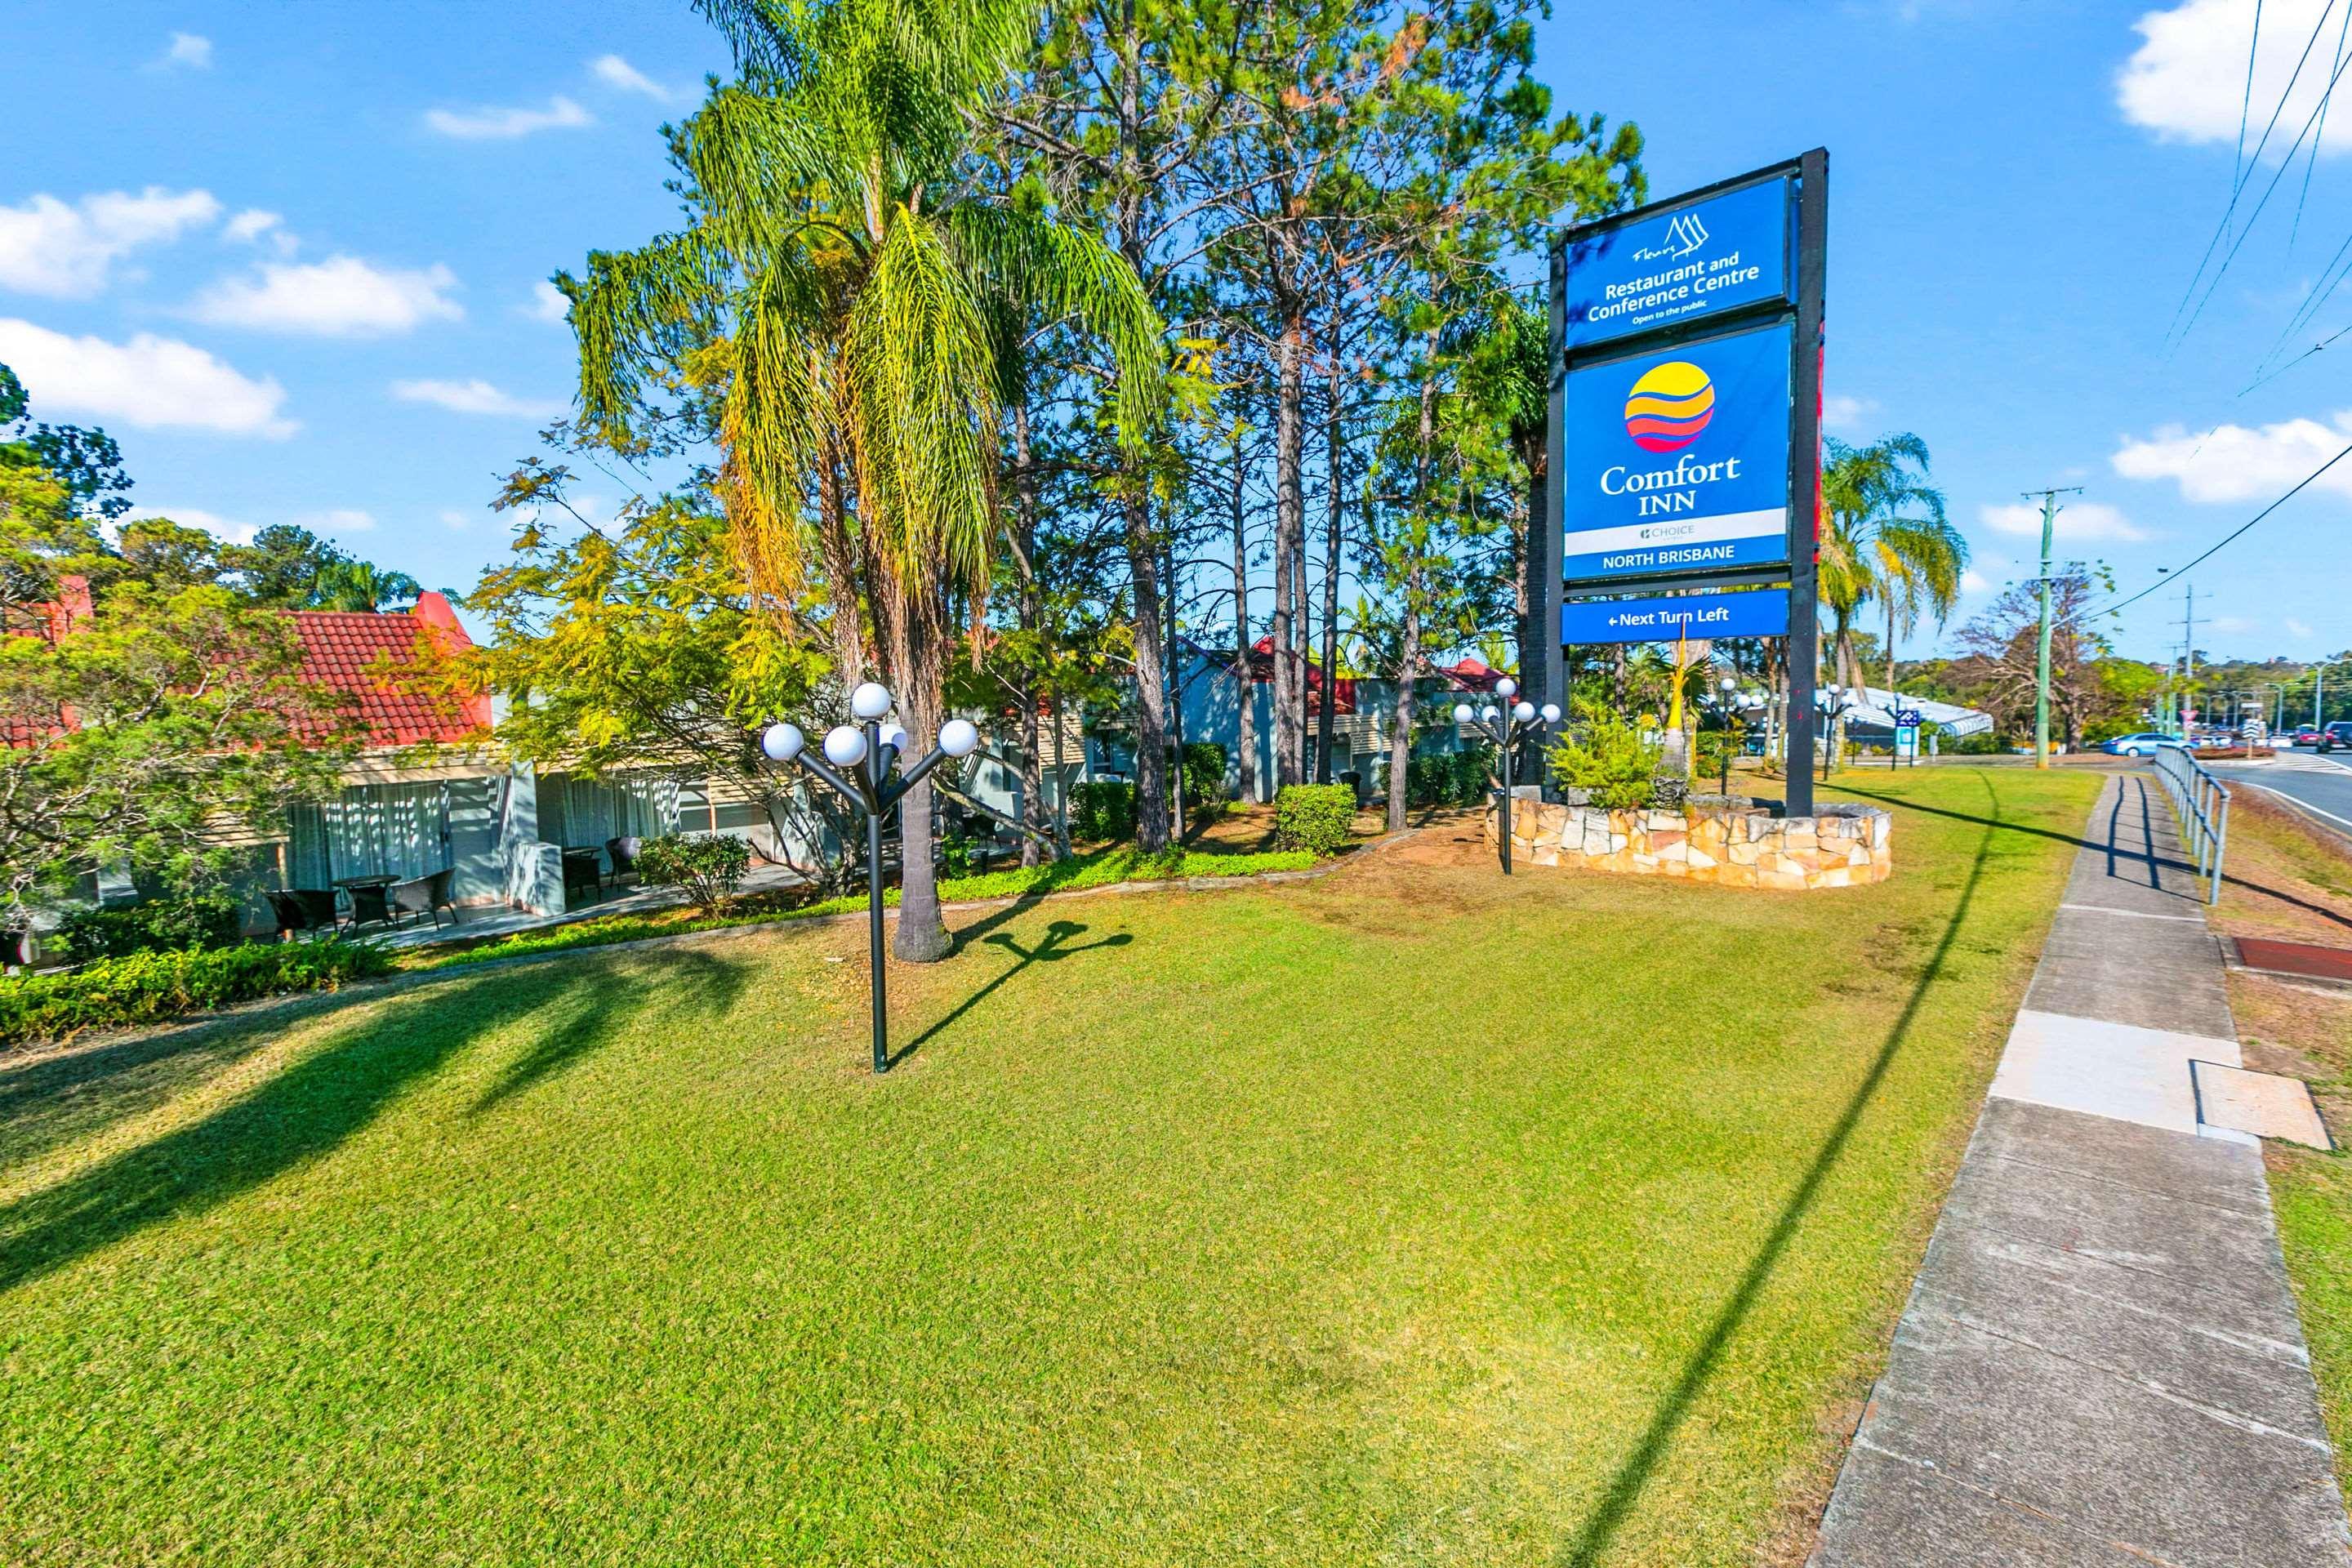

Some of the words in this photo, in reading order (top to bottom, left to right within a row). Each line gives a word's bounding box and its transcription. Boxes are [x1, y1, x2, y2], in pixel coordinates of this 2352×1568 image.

[1605, 260, 1705, 301] Restaurant
[1708, 251, 1740, 272] and
[1588, 285, 1689, 323] Conference
[1694, 266, 1759, 294] Centre
[1633, 314, 1655, 325] Open
[1655, 311, 1664, 319] to
[1666, 307, 1680, 316] the
[1681, 300, 1708, 314] public
[1600, 454, 1741, 496] Comfort
[1638, 490, 1697, 516] INN
[1651, 525, 1695, 537] CHOICE
[1603, 553, 1654, 568] NORTH
[1659, 545, 1735, 564] BRISBANE
[1619, 612, 1655, 626] Next
[1658, 611, 1693, 624] Turn
[1697, 607, 1729, 622] Left
